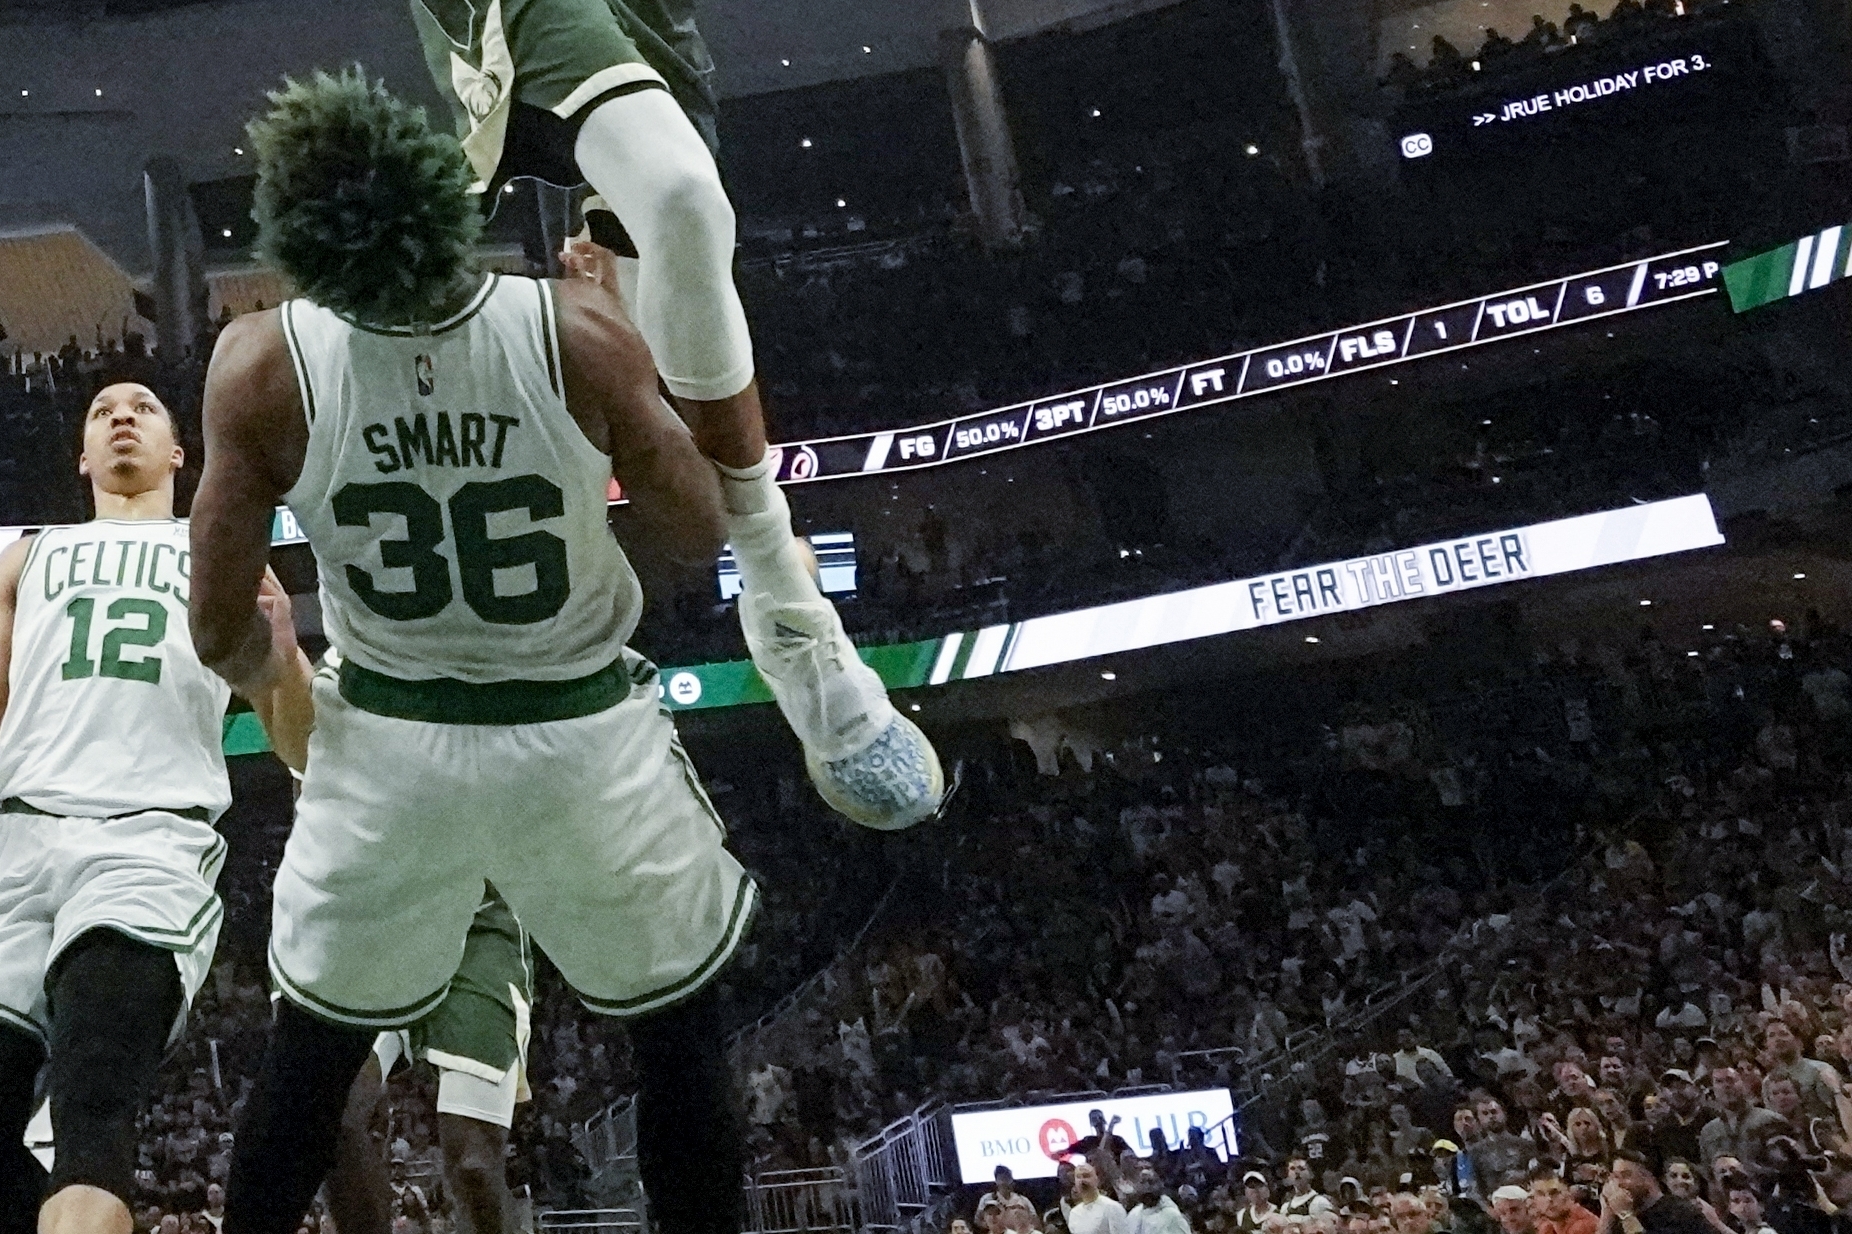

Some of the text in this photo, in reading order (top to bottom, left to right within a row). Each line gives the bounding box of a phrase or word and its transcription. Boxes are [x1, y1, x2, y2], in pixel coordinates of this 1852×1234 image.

[1501, 55, 1711, 121] JRUE HOLIDAY FOR 3.
[1405, 138, 1429, 154] CC
[1654, 265, 1700, 290] 7:29
[899, 287, 1604, 459] FG 50.0% 3PT 50.0% FT 0.0% FLS 1 TOL 6
[363, 411, 519, 473] SMART
[335, 472, 571, 625] 36
[1249, 534, 1528, 621] FEAR THE DEER
[62, 598, 168, 684] 12
[980, 1137, 1031, 1158] BMO
